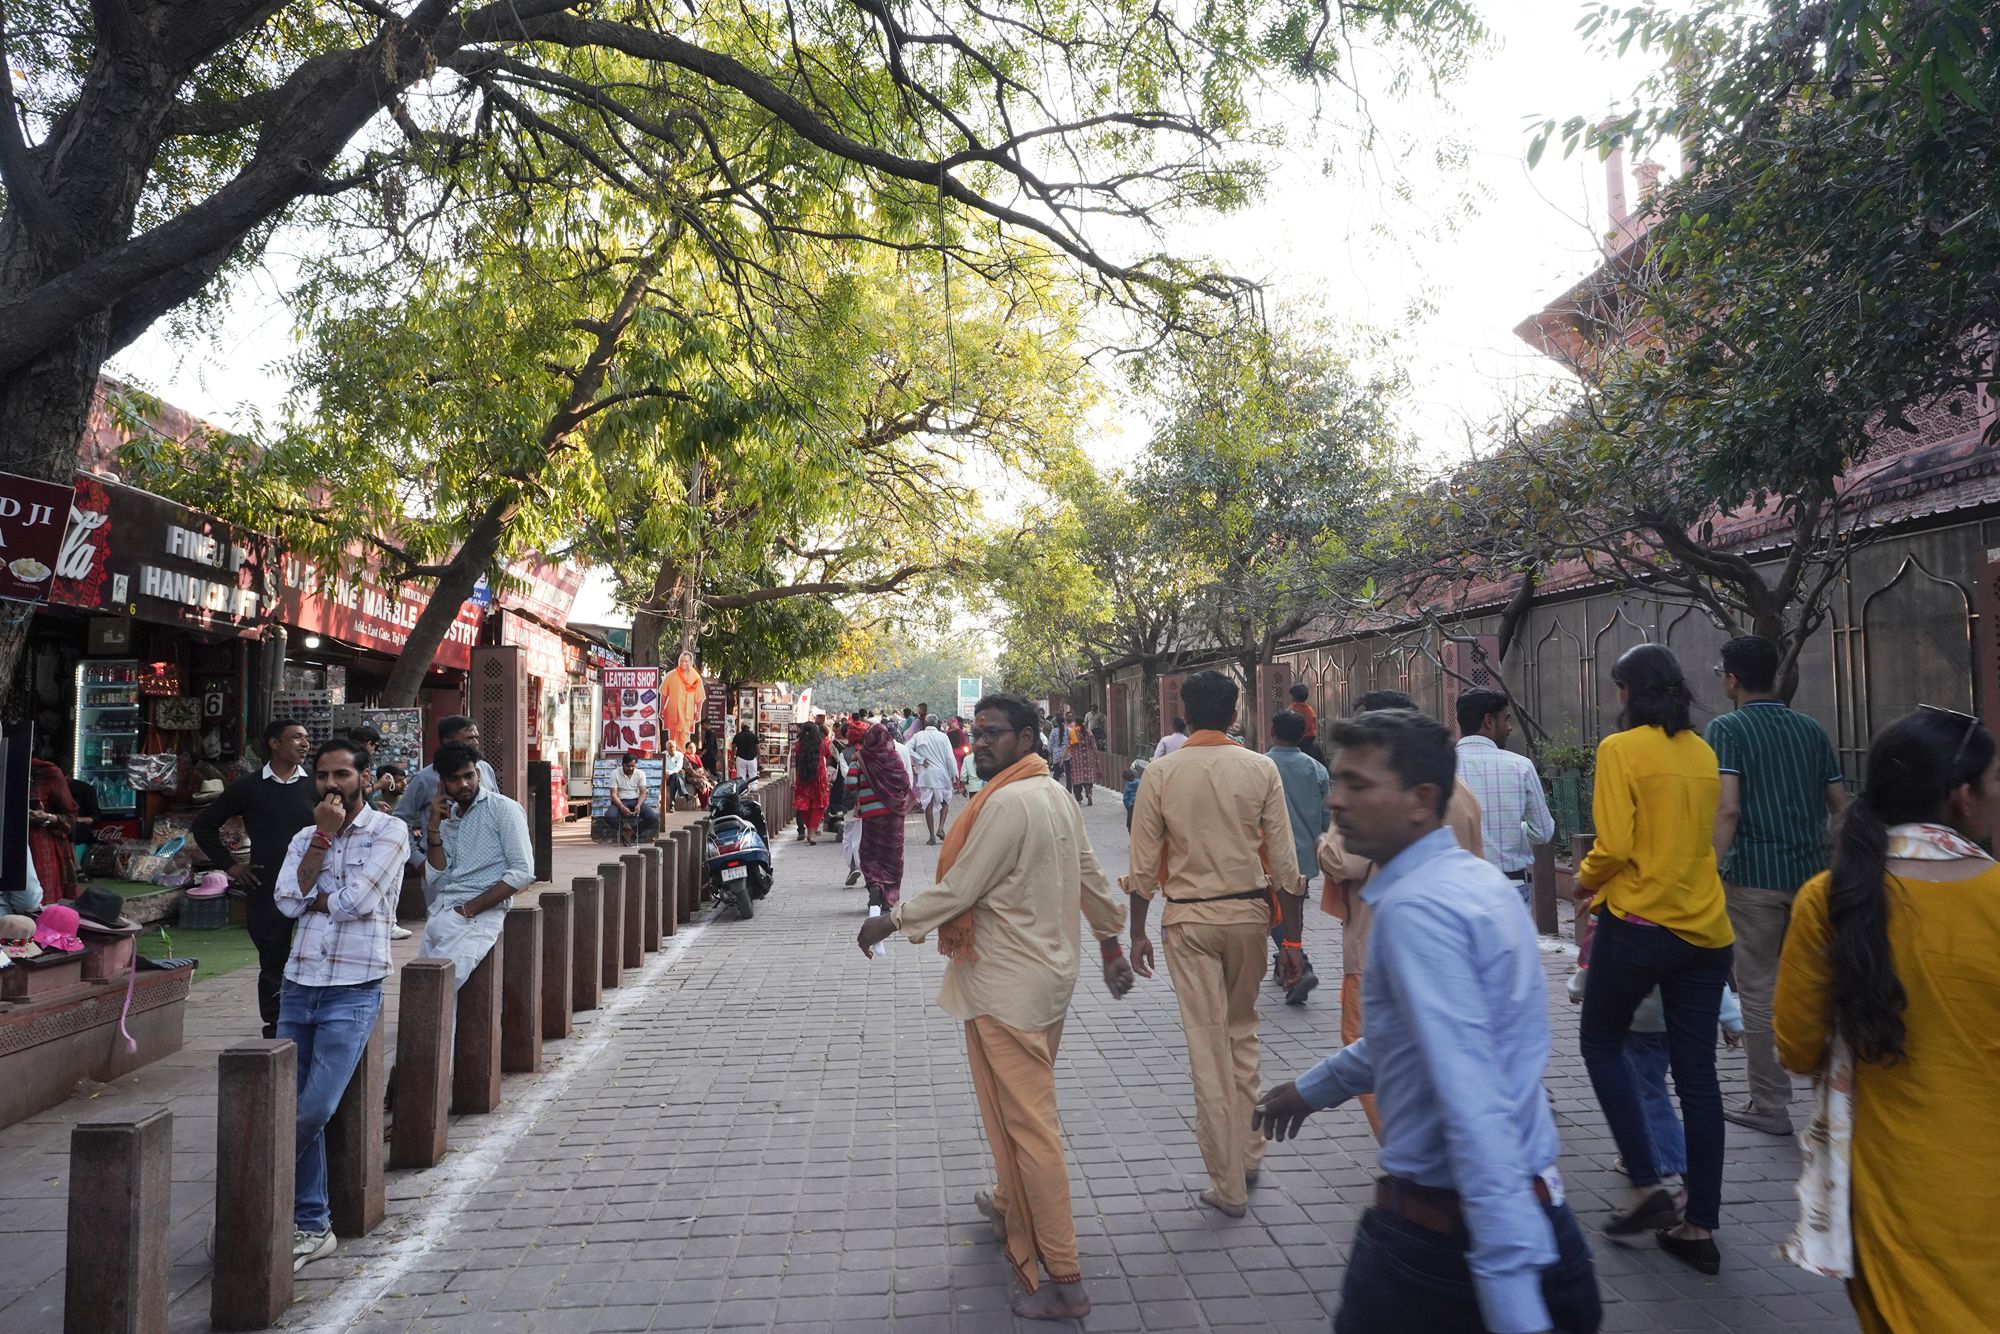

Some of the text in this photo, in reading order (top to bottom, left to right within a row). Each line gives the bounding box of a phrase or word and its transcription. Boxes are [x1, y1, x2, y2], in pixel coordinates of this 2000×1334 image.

[22, 503, 54, 527] JI
[166, 525, 213, 567] FINE
[129, 603, 136, 615] 6
[363, 588, 418, 630] MARBLE
[605, 671, 636, 687] LEATHER
[637, 672, 656, 687] SHOP
[206, 694, 220, 714] 6
